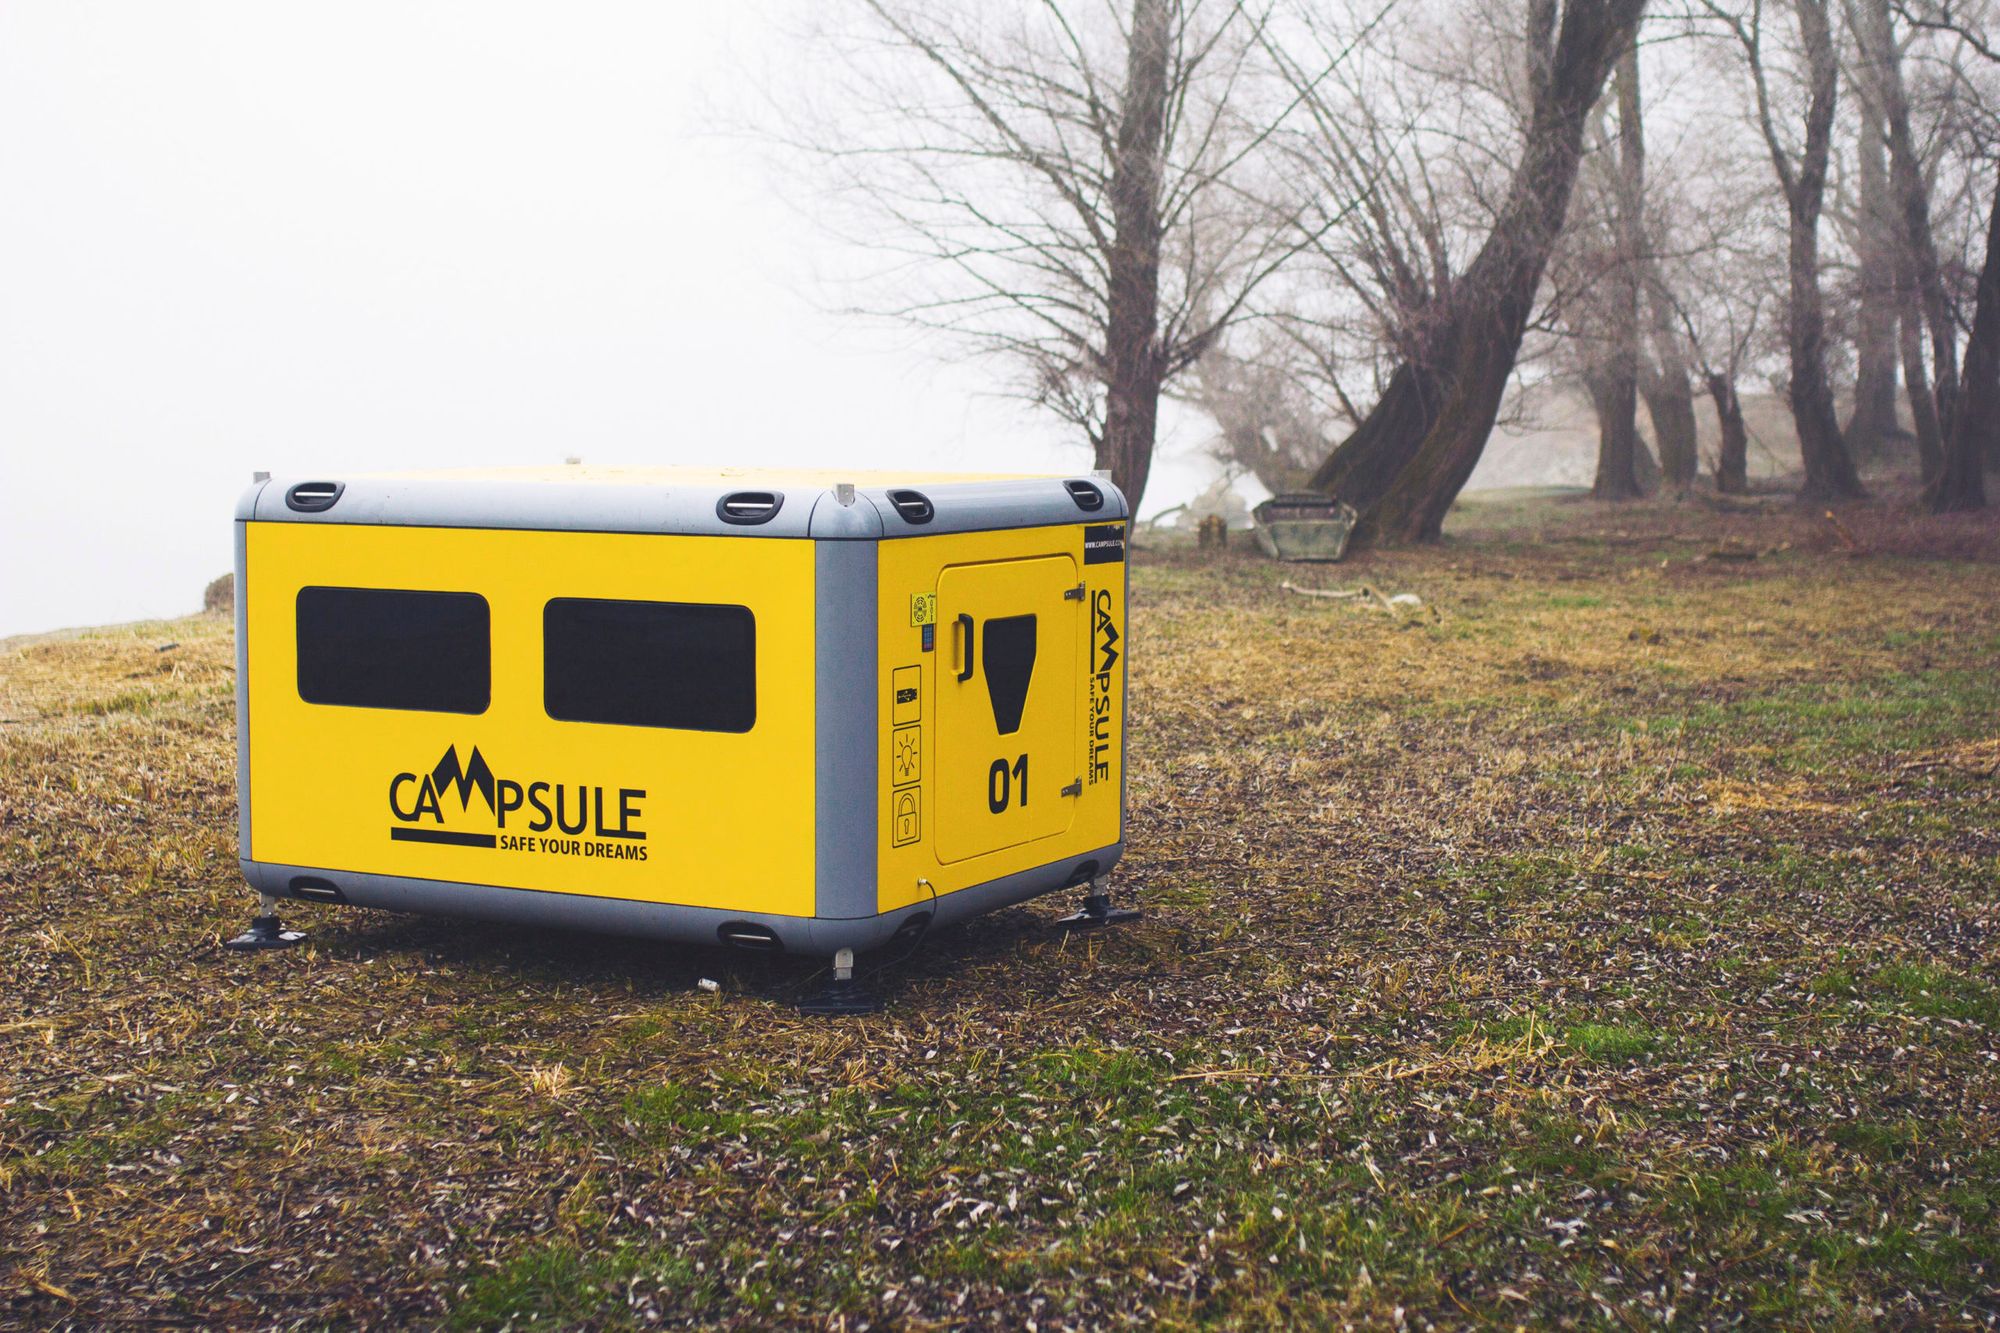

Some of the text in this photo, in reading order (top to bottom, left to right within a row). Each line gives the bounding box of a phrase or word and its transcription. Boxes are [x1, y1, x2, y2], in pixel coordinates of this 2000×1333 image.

[1095, 589, 1119, 784] CAMPSULE
[389, 743, 647, 841] CAMPSULE
[988, 753, 1028, 815] 01
[500, 835, 648, 861] SAFE YOUR DREAMS
